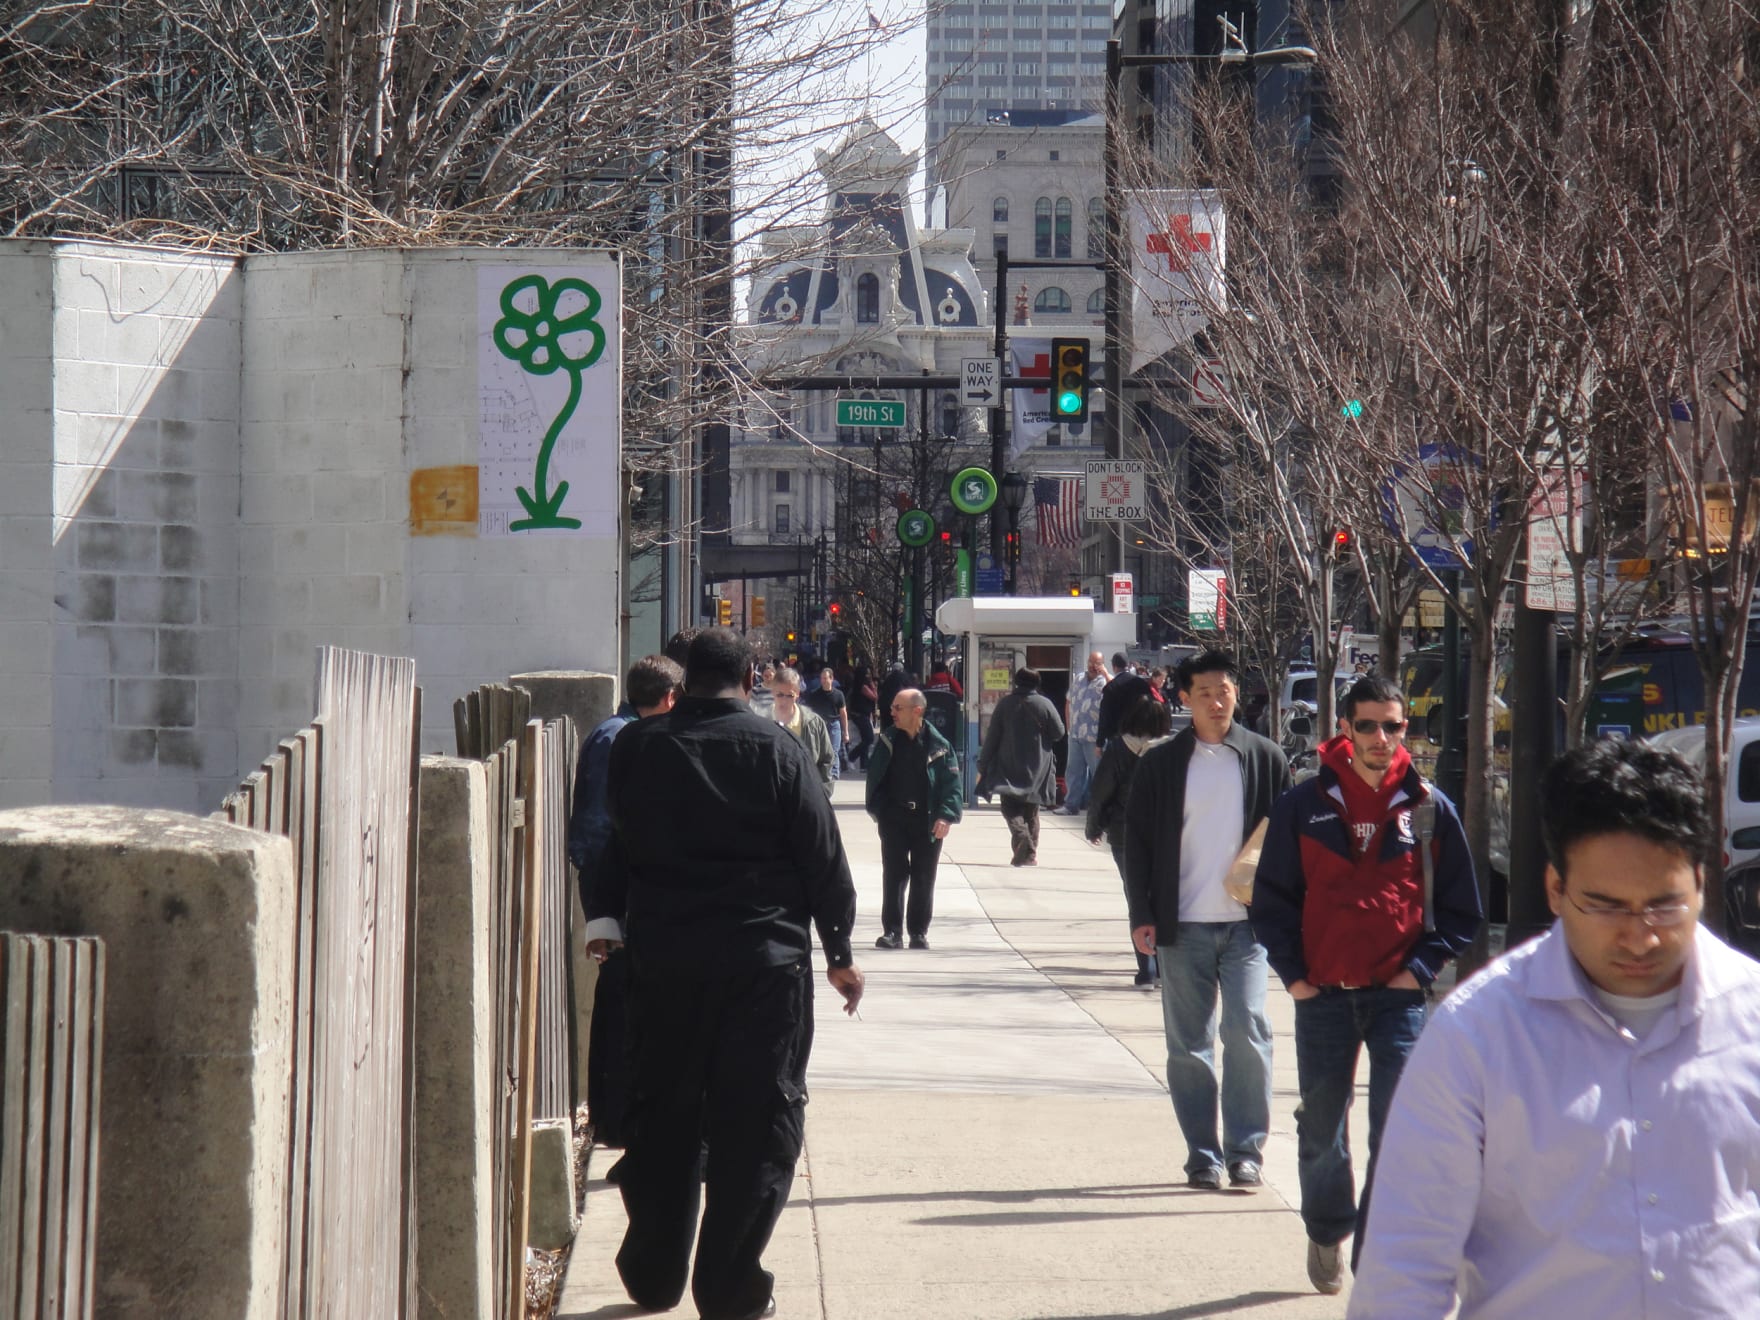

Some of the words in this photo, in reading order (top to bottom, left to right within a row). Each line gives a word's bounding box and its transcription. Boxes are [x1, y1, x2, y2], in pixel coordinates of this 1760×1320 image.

[967, 362, 993, 374] ONE
[966, 375, 993, 387] WAY
[848, 405, 877, 421] 19th
[881, 406, 894, 422] St
[1088, 462, 1112, 474] DONT
[1114, 462, 1143, 474] BLOCK
[1089, 506, 1112, 519] THE
[1118, 506, 1142, 518] BOX
